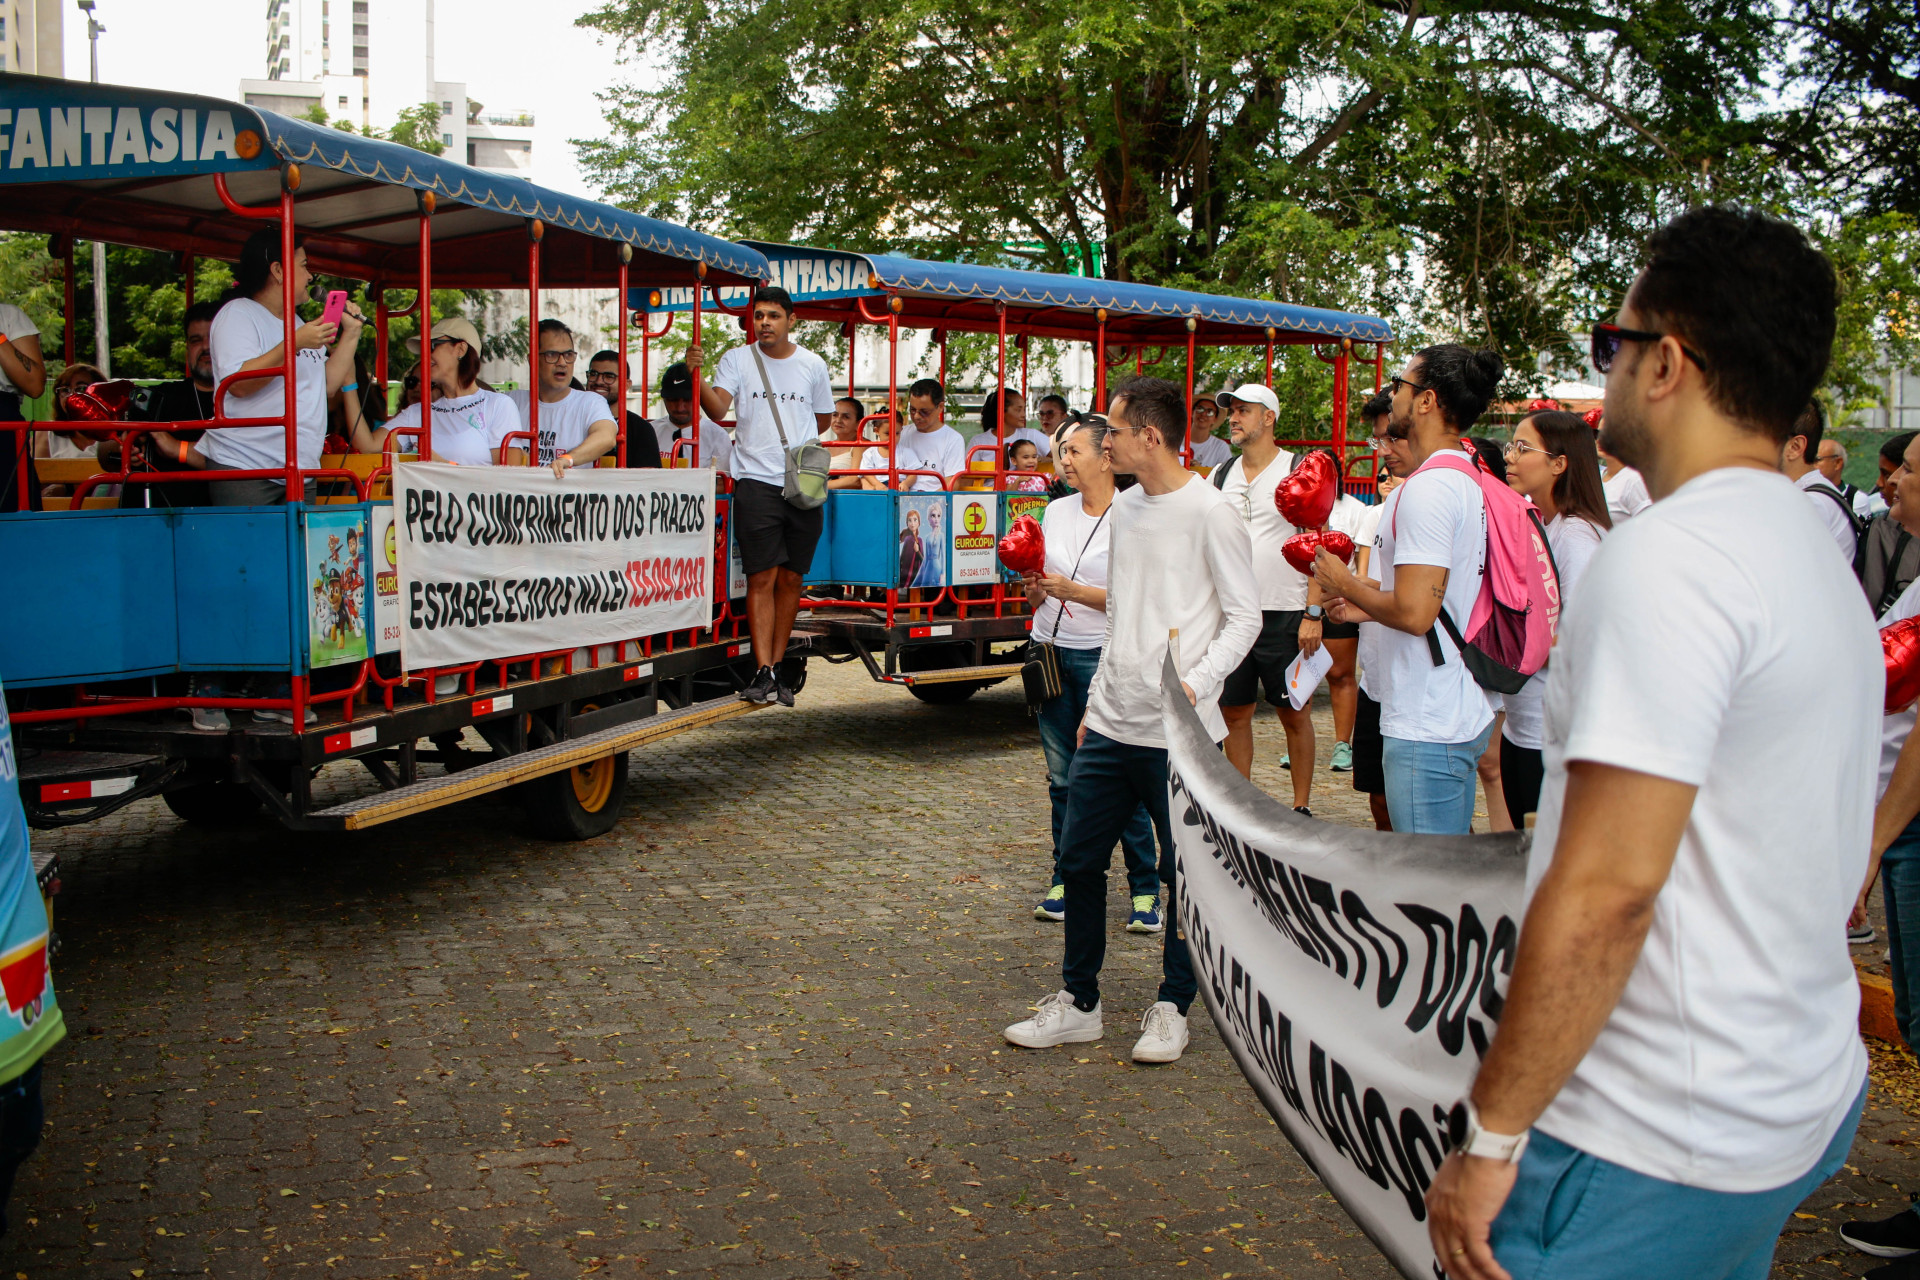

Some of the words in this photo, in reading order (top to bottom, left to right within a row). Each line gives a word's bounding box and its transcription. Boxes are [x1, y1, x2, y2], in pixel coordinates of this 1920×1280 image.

[767, 259, 871, 295] ANTASIA
[405, 488, 464, 544] PELO
[467, 492, 609, 546] CUMPRIMENTO
[613, 493, 646, 541] DOS
[649, 491, 705, 535] PRAZOS
[410, 576, 576, 630] ESTABELECIDOS
[575, 573, 601, 614] NA
[600, 570, 628, 613] LEI
